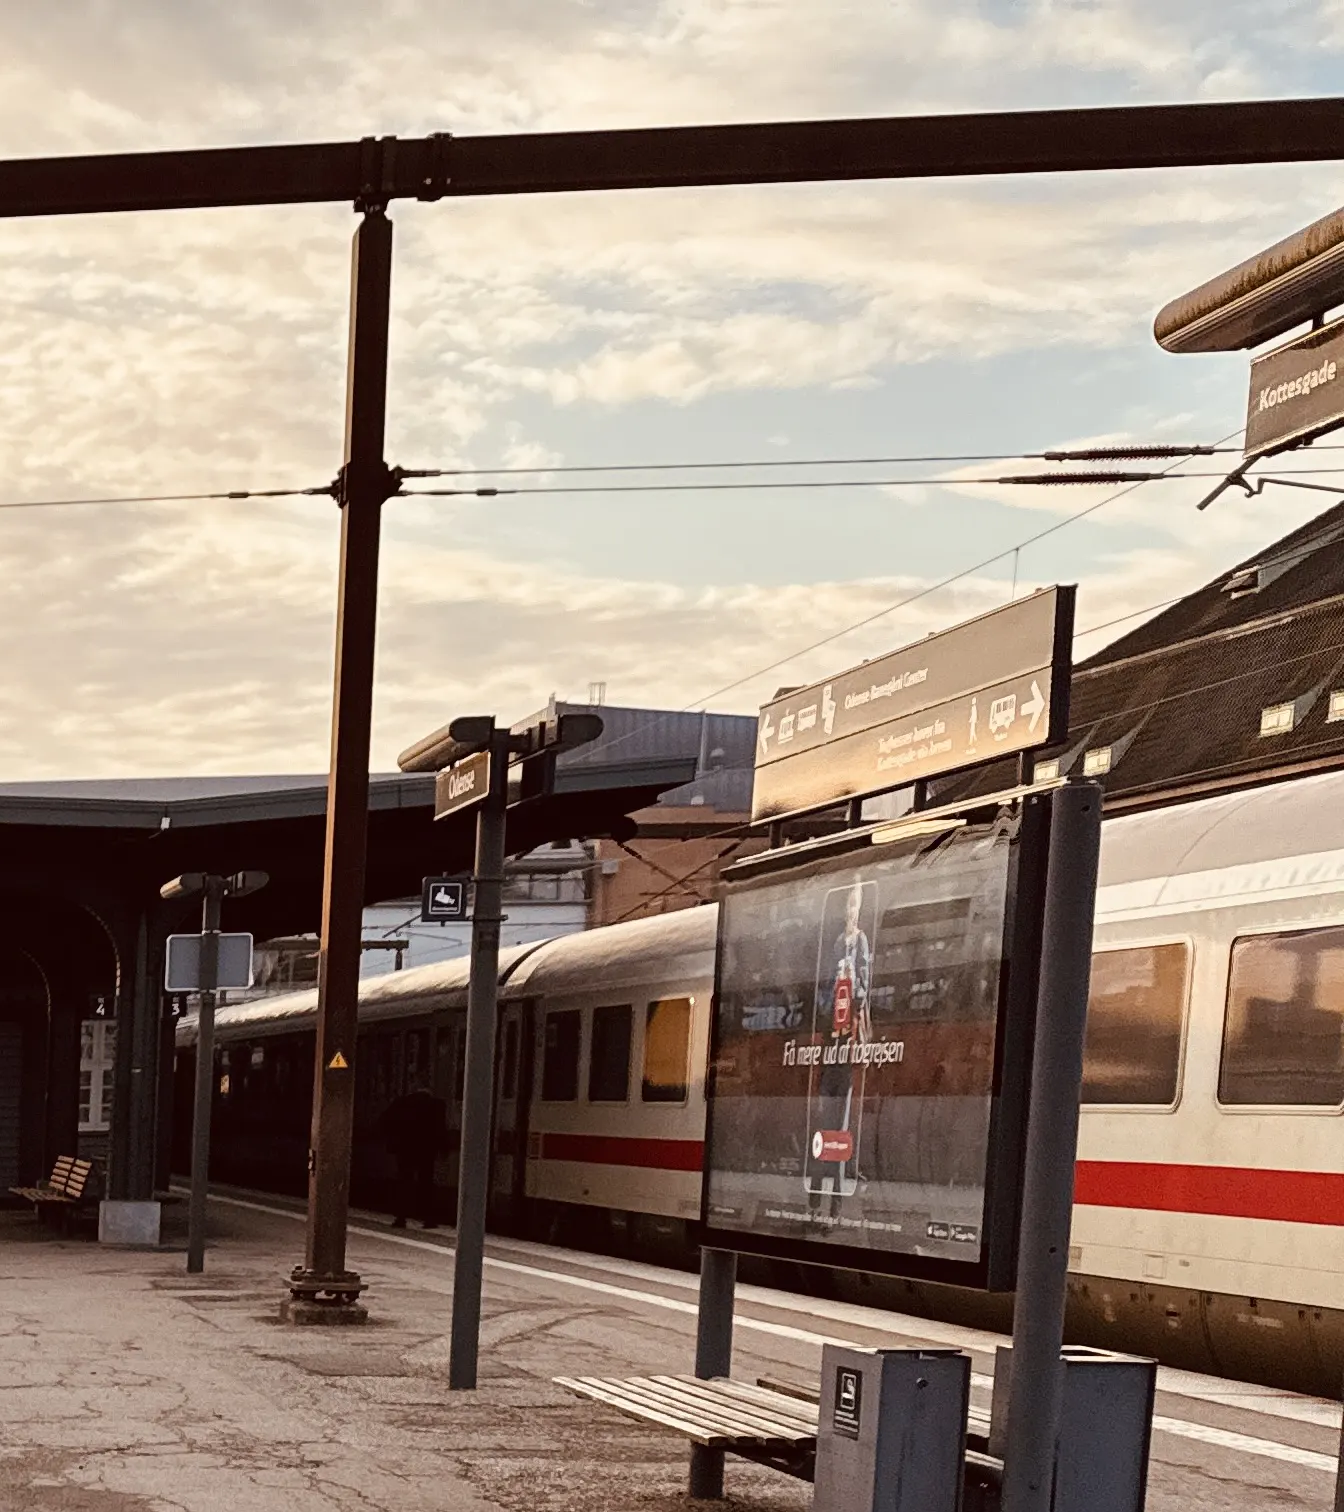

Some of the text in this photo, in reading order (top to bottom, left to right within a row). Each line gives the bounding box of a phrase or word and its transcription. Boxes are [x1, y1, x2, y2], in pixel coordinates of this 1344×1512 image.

[1258, 359, 1337, 411] Kottesgade
[448, 769, 475, 800] Odense
[95, 1003, 105, 1016] 4
[171, 1003, 180, 1016] 3
[781, 1036, 905, 1069] Få mere ud af togrejsen
